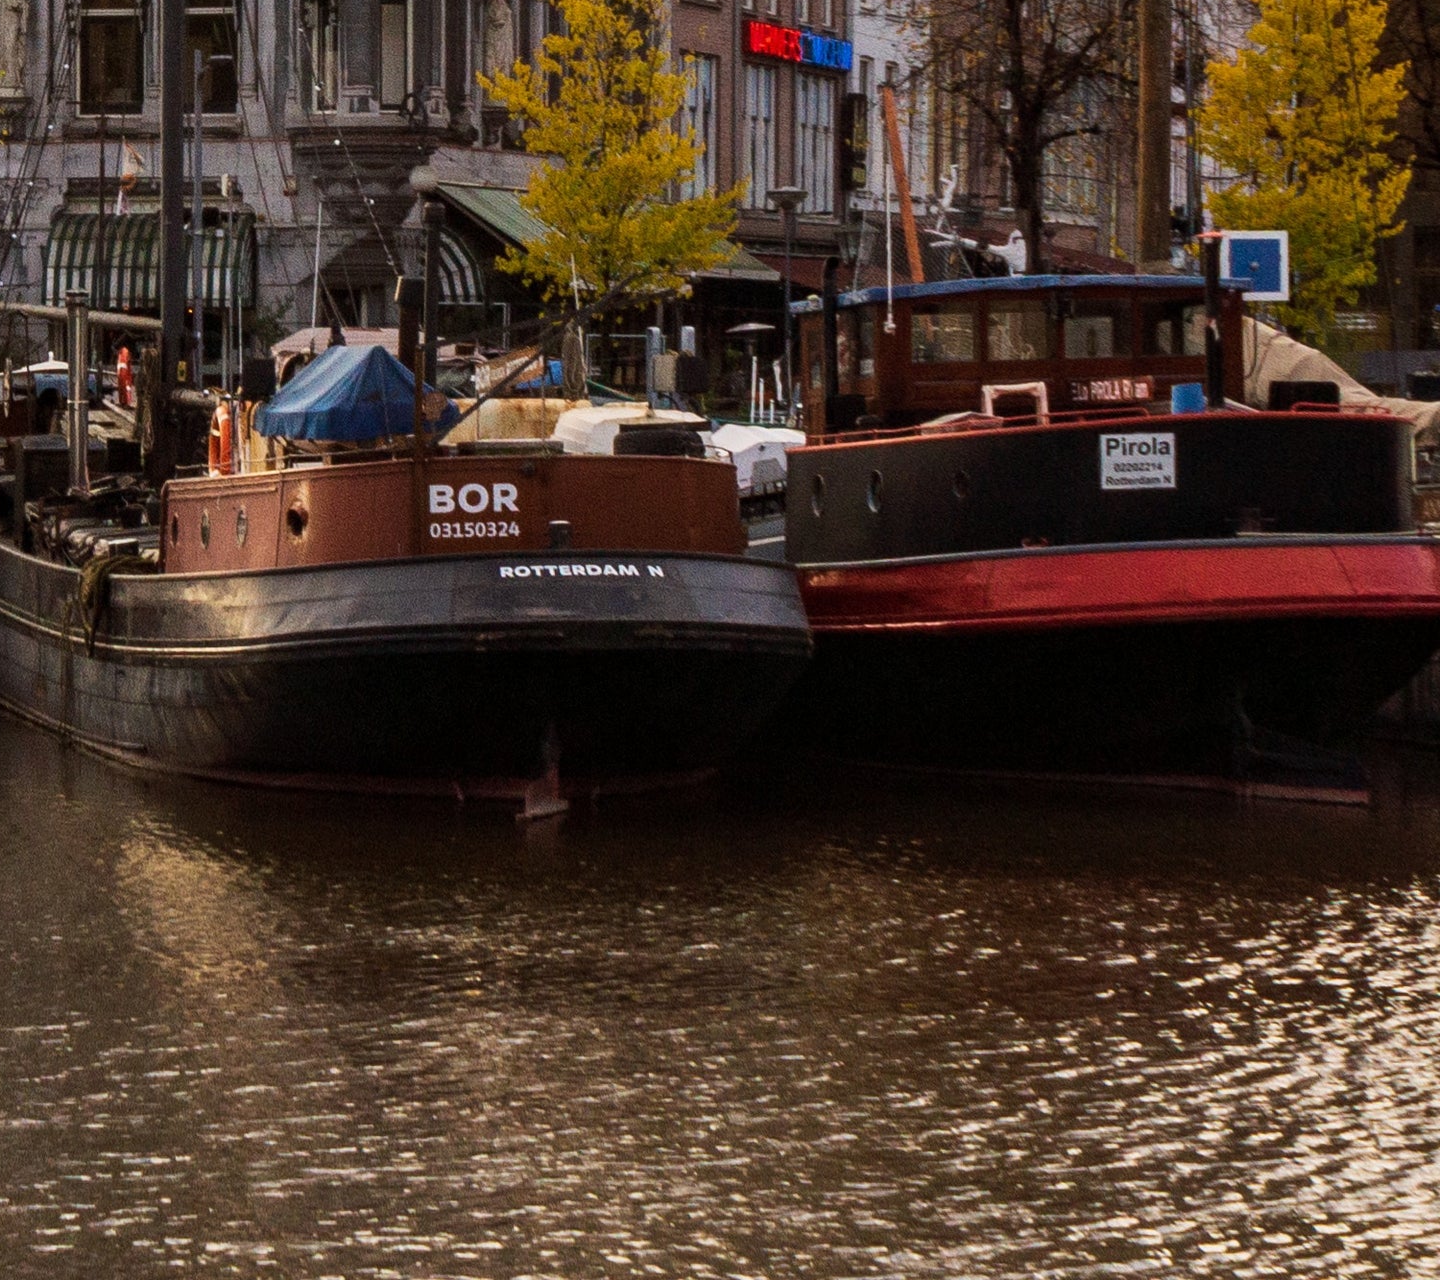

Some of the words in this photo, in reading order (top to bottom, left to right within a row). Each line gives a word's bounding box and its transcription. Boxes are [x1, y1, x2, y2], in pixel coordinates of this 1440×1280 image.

[1106, 437, 1171, 456] Pirola
[429, 483, 520, 513] BOR
[430, 521, 520, 538] 03150324
[499, 564, 640, 578] ROTTERDAM
[647, 565, 665, 578] N
